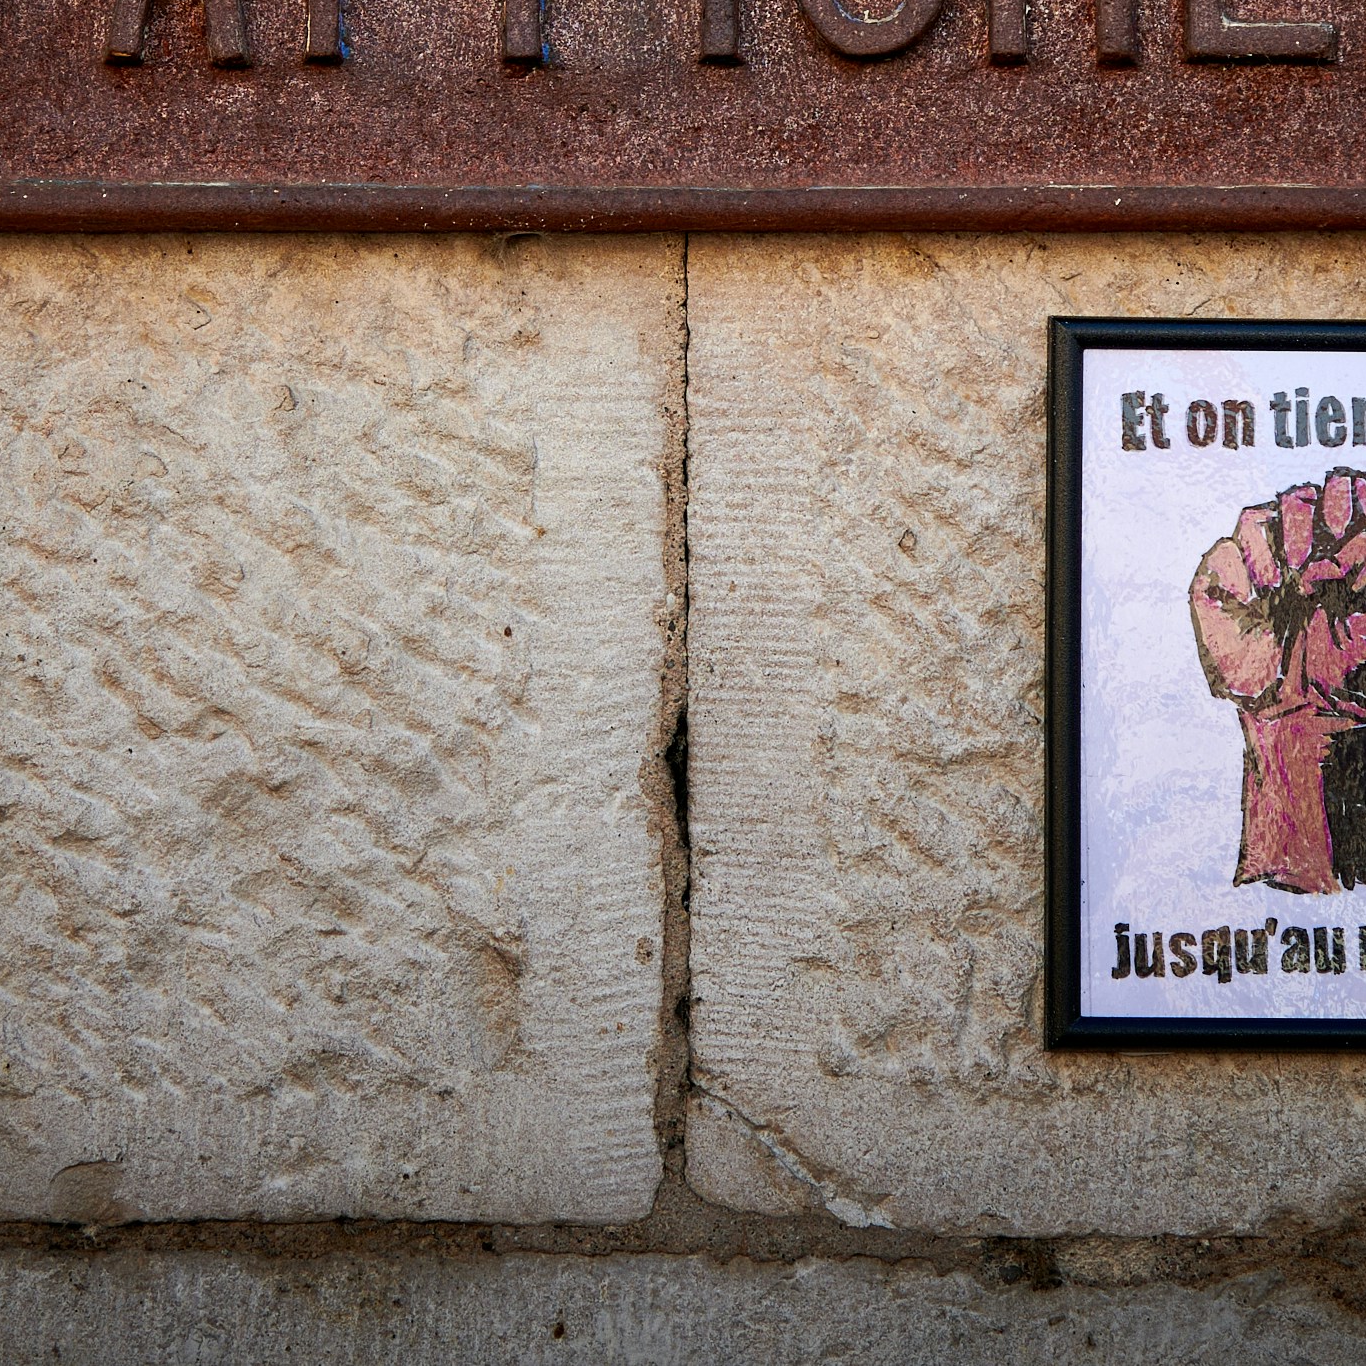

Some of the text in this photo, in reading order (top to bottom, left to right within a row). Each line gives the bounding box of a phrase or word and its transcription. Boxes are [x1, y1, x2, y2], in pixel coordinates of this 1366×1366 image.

[1121, 390, 1170, 450] Et
[1185, 393, 1256, 449] on
[1111, 917, 1345, 983] jusqu'au
